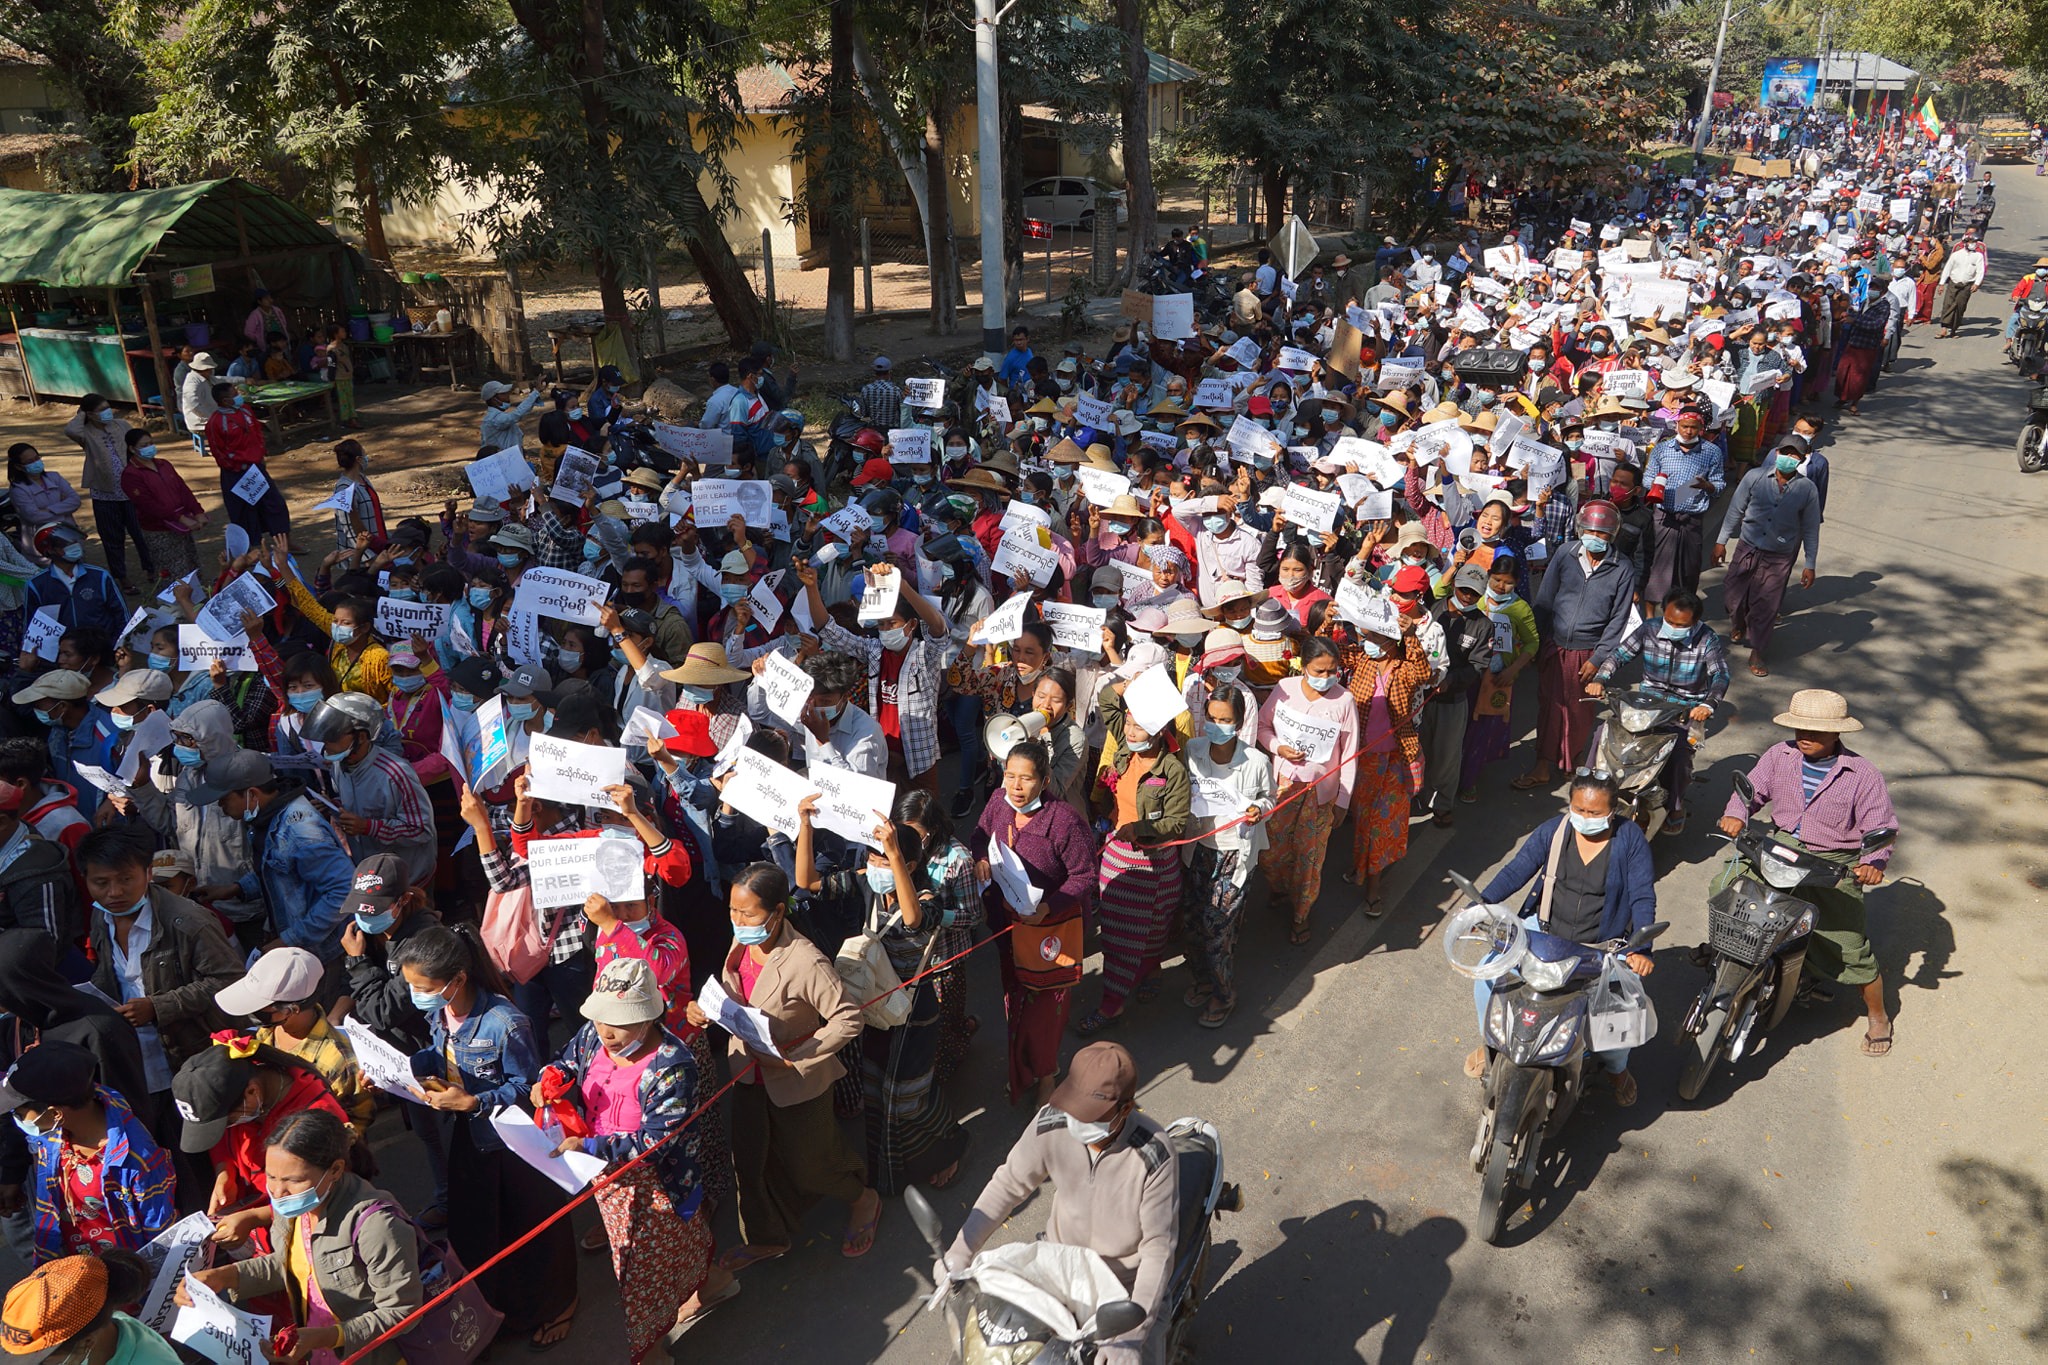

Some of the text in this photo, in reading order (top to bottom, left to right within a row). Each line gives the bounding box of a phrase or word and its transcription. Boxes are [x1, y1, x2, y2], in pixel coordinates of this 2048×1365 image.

[694, 493, 708, 501] OUR
[706, 483, 726, 491] WANT
[695, 505, 728, 517] FREE
[523, 569, 606, 597] စစ်အာဏာရှင်
[381, 601, 445, 625] ရုံးမတက်နဲ့
[539, 595, 587, 616] အလိုမရှိ
[1044, 607, 1103, 630] စစ်အာဏာရှင်
[1057, 628, 1090, 650] အလိုမရှိ
[1276, 708, 1336, 742] စစ်အာဏာရှင်
[556, 765, 599, 787] အသိုက်ထဲမှာ
[549, 843, 579, 855] WANT
[531, 854, 596, 868] OUR LEADER
[534, 872, 582, 892] FREE
[536, 895, 559, 906] DAW
